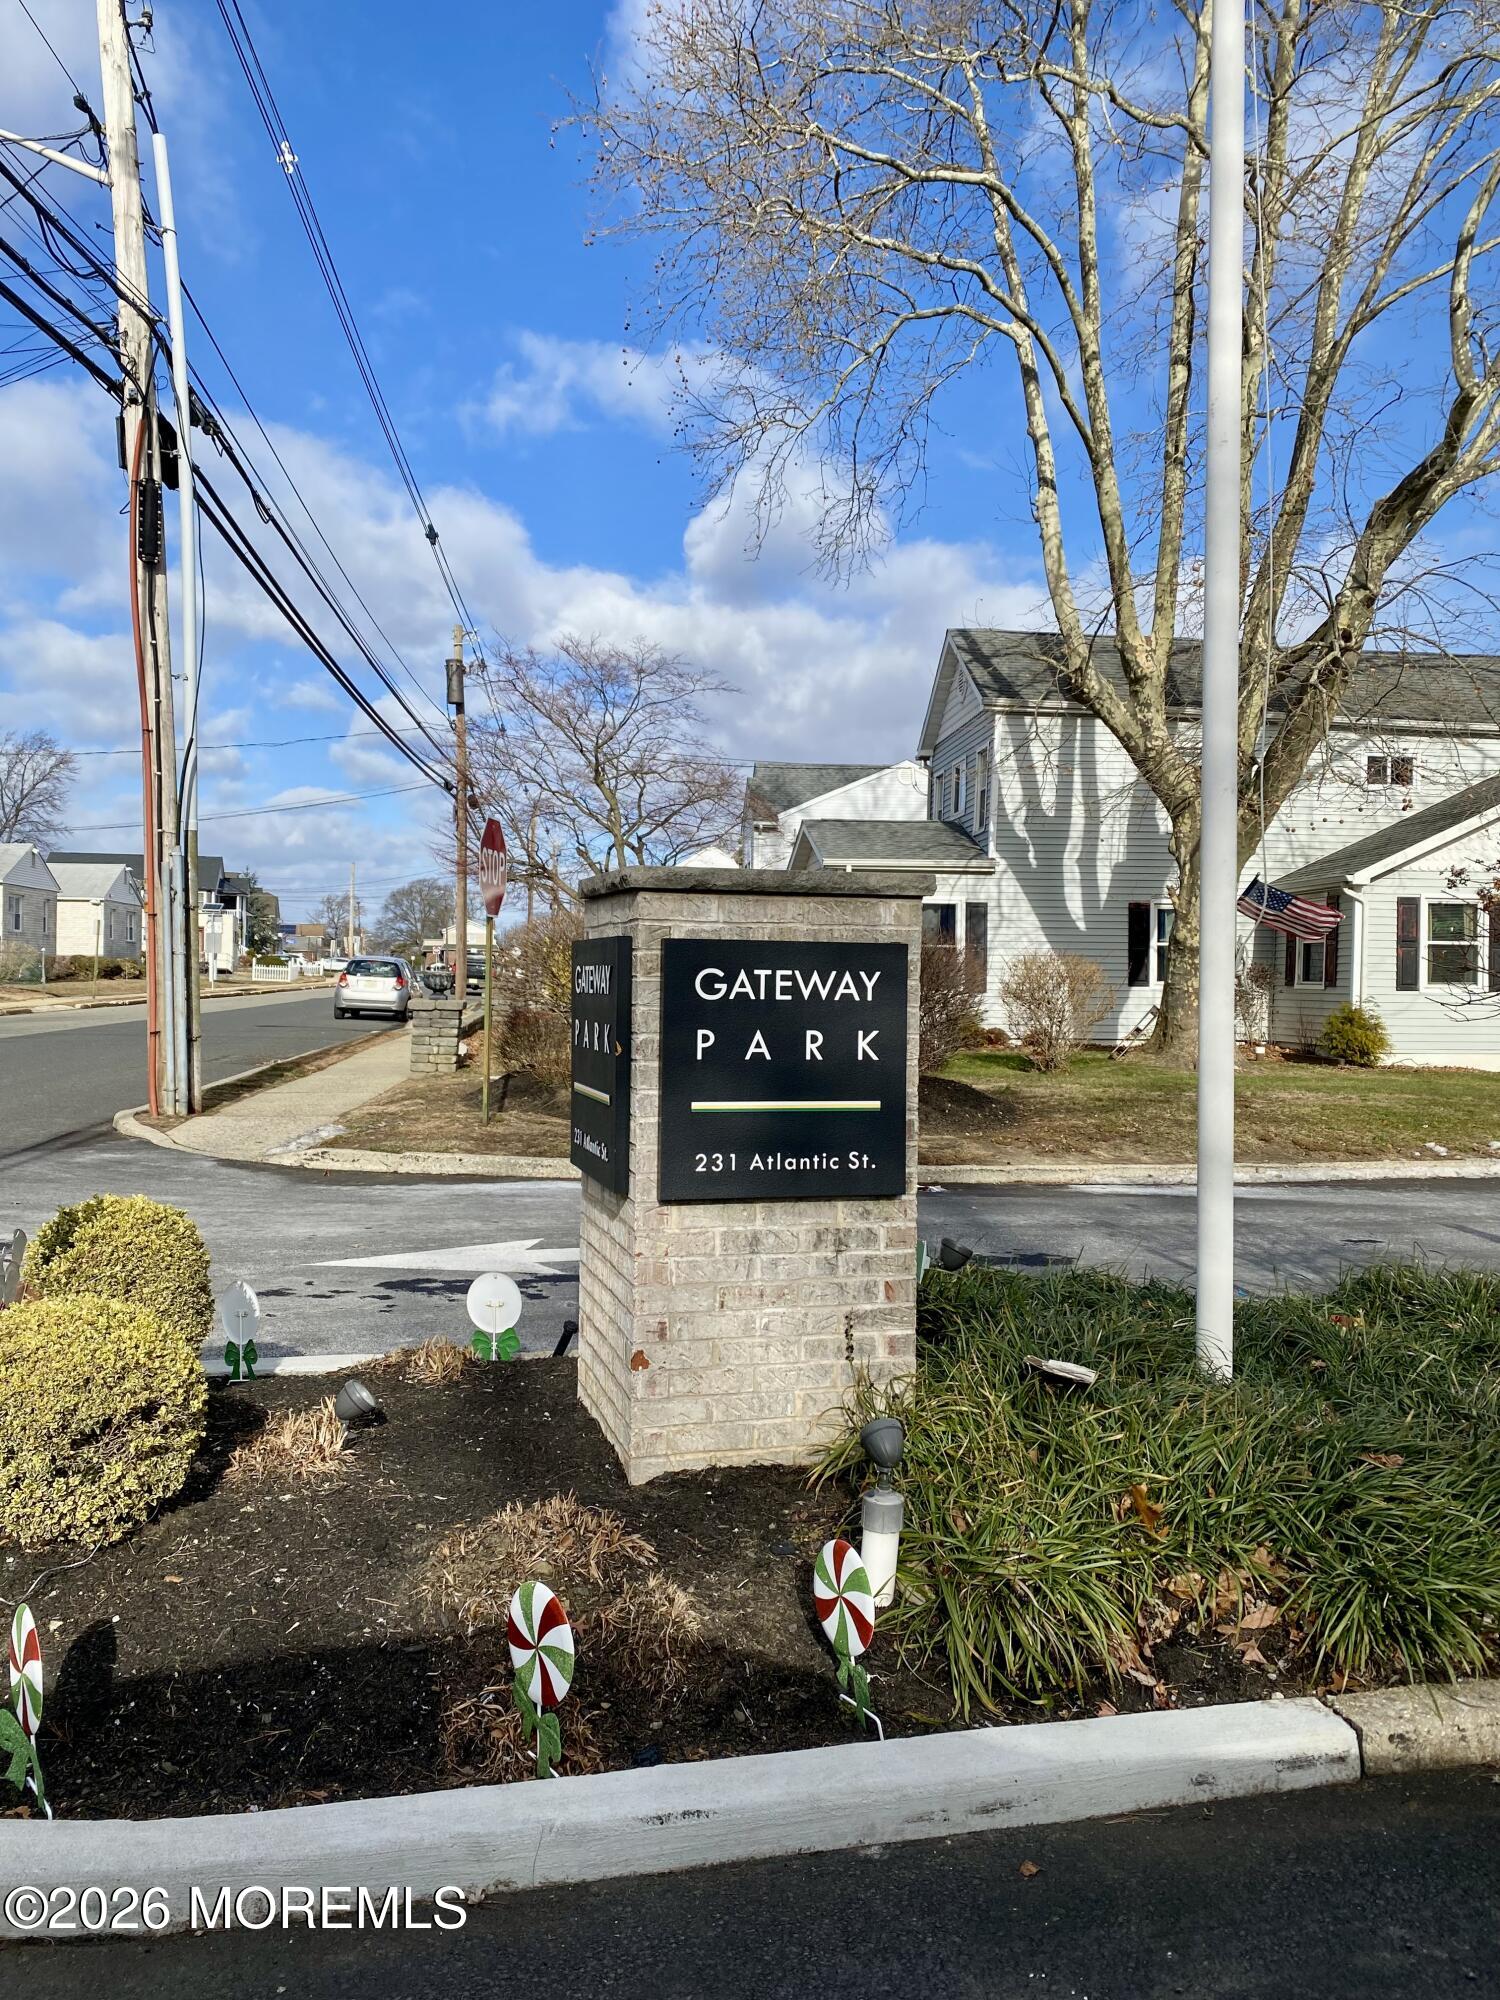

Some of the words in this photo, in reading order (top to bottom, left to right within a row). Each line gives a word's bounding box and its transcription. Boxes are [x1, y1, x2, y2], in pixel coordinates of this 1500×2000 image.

[481, 846, 505, 886] STOP
[574, 964, 611, 995] GATEWAY
[694, 967, 882, 1001] GATEWAY
[574, 1018, 610, 1054] PARK
[696, 1028, 880, 1061] PARK
[574, 1127, 583, 1147] 231
[695, 1152, 736, 1172] 231
[749, 1151, 840, 1171] Atlantic
[848, 1150, 876, 1170] St.
